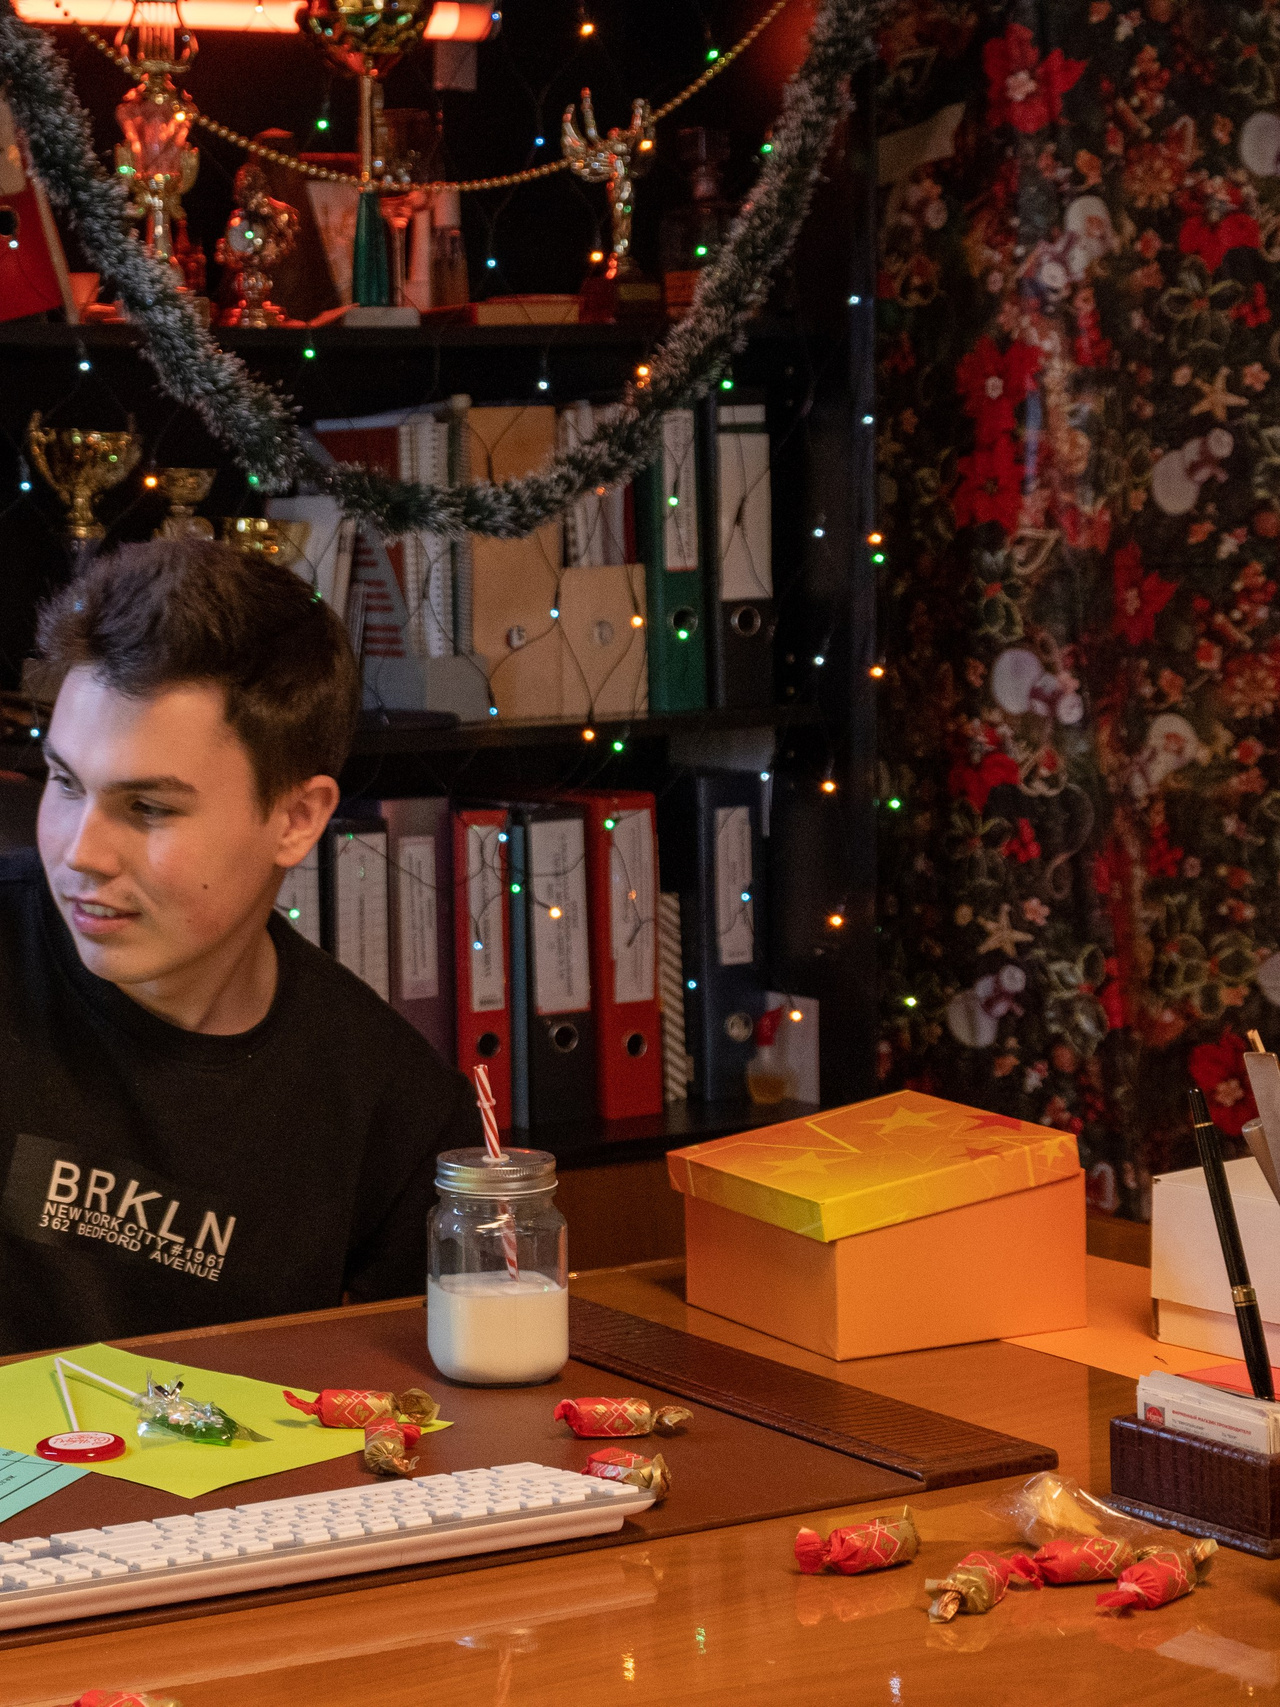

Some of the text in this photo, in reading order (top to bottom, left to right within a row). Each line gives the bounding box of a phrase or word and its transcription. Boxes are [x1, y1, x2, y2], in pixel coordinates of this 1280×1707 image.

[43, 1201, 225, 1270] NEW YORK CITY #1961
[48, 1160, 236, 1257] BRKLN
[39, 1215, 221, 1282] 362 BEDFORD AVENUE
